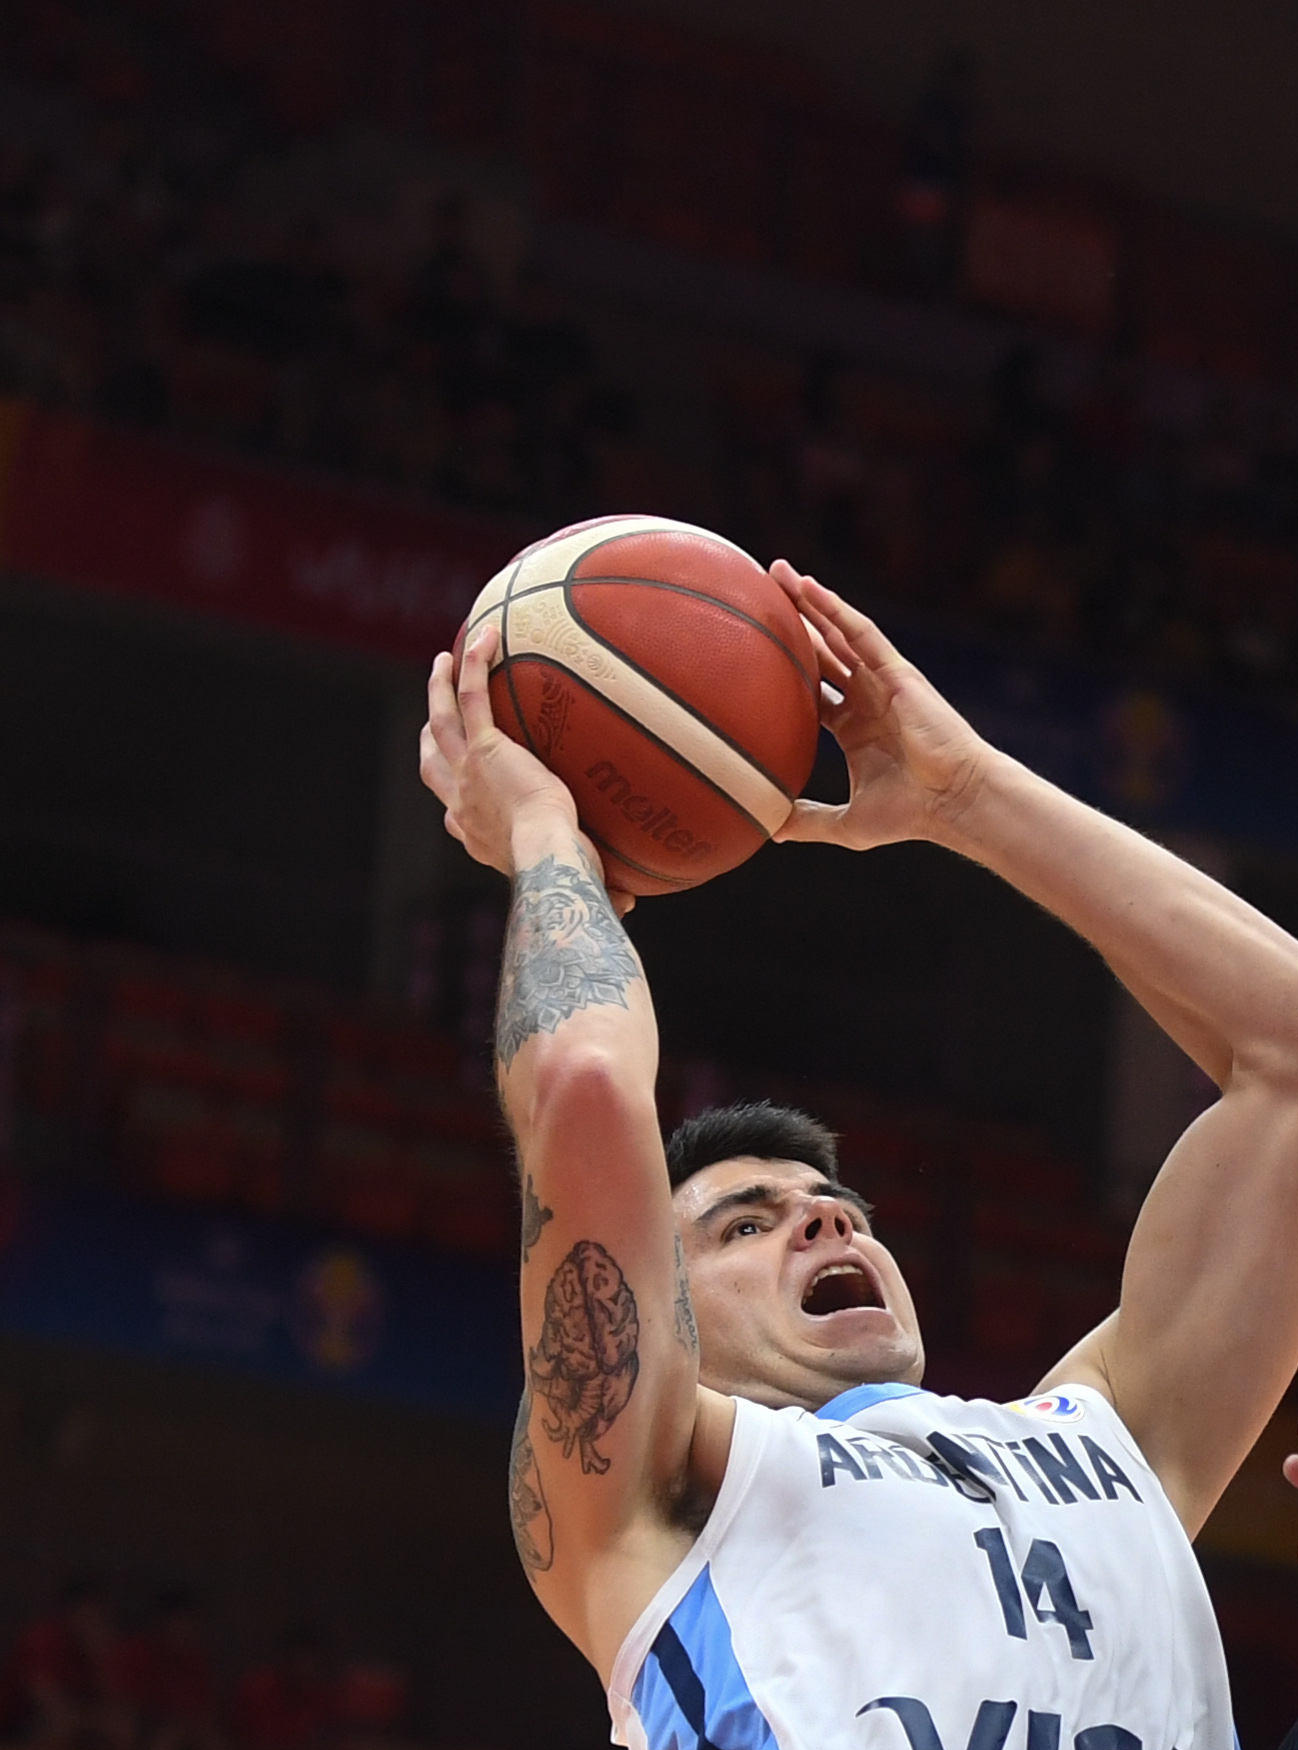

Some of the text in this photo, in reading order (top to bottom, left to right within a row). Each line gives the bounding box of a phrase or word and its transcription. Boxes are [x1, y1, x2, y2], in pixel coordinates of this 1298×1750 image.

[584, 760, 712, 862] molten
[815, 1430, 1145, 1506] ARNTINA
[973, 1526, 1095, 1661] 14
